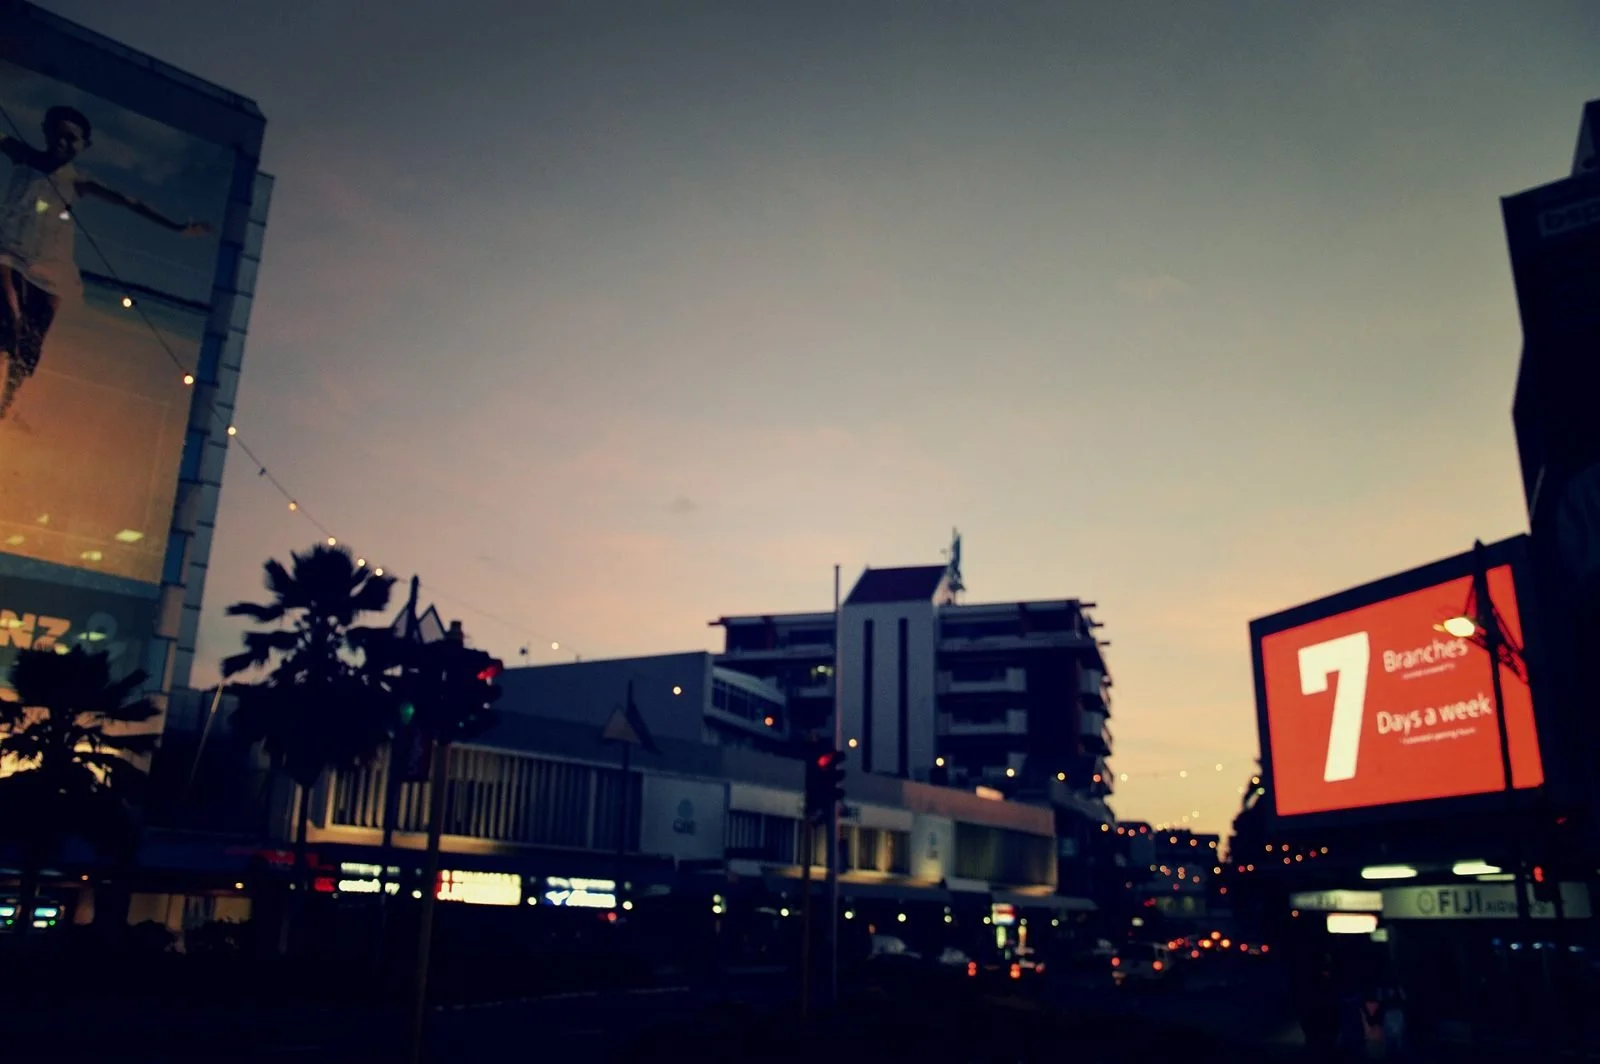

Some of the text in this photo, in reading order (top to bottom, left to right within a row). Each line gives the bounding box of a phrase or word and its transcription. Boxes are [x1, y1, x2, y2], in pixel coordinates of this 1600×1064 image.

[1382, 637, 1468, 672] Branches
[1298, 630, 1370, 783] 7
[1376, 708, 1422, 736] Days
[1424, 707, 1437, 726] a
[1439, 691, 1492, 723] week
[1437, 888, 1482, 914] FIJI
